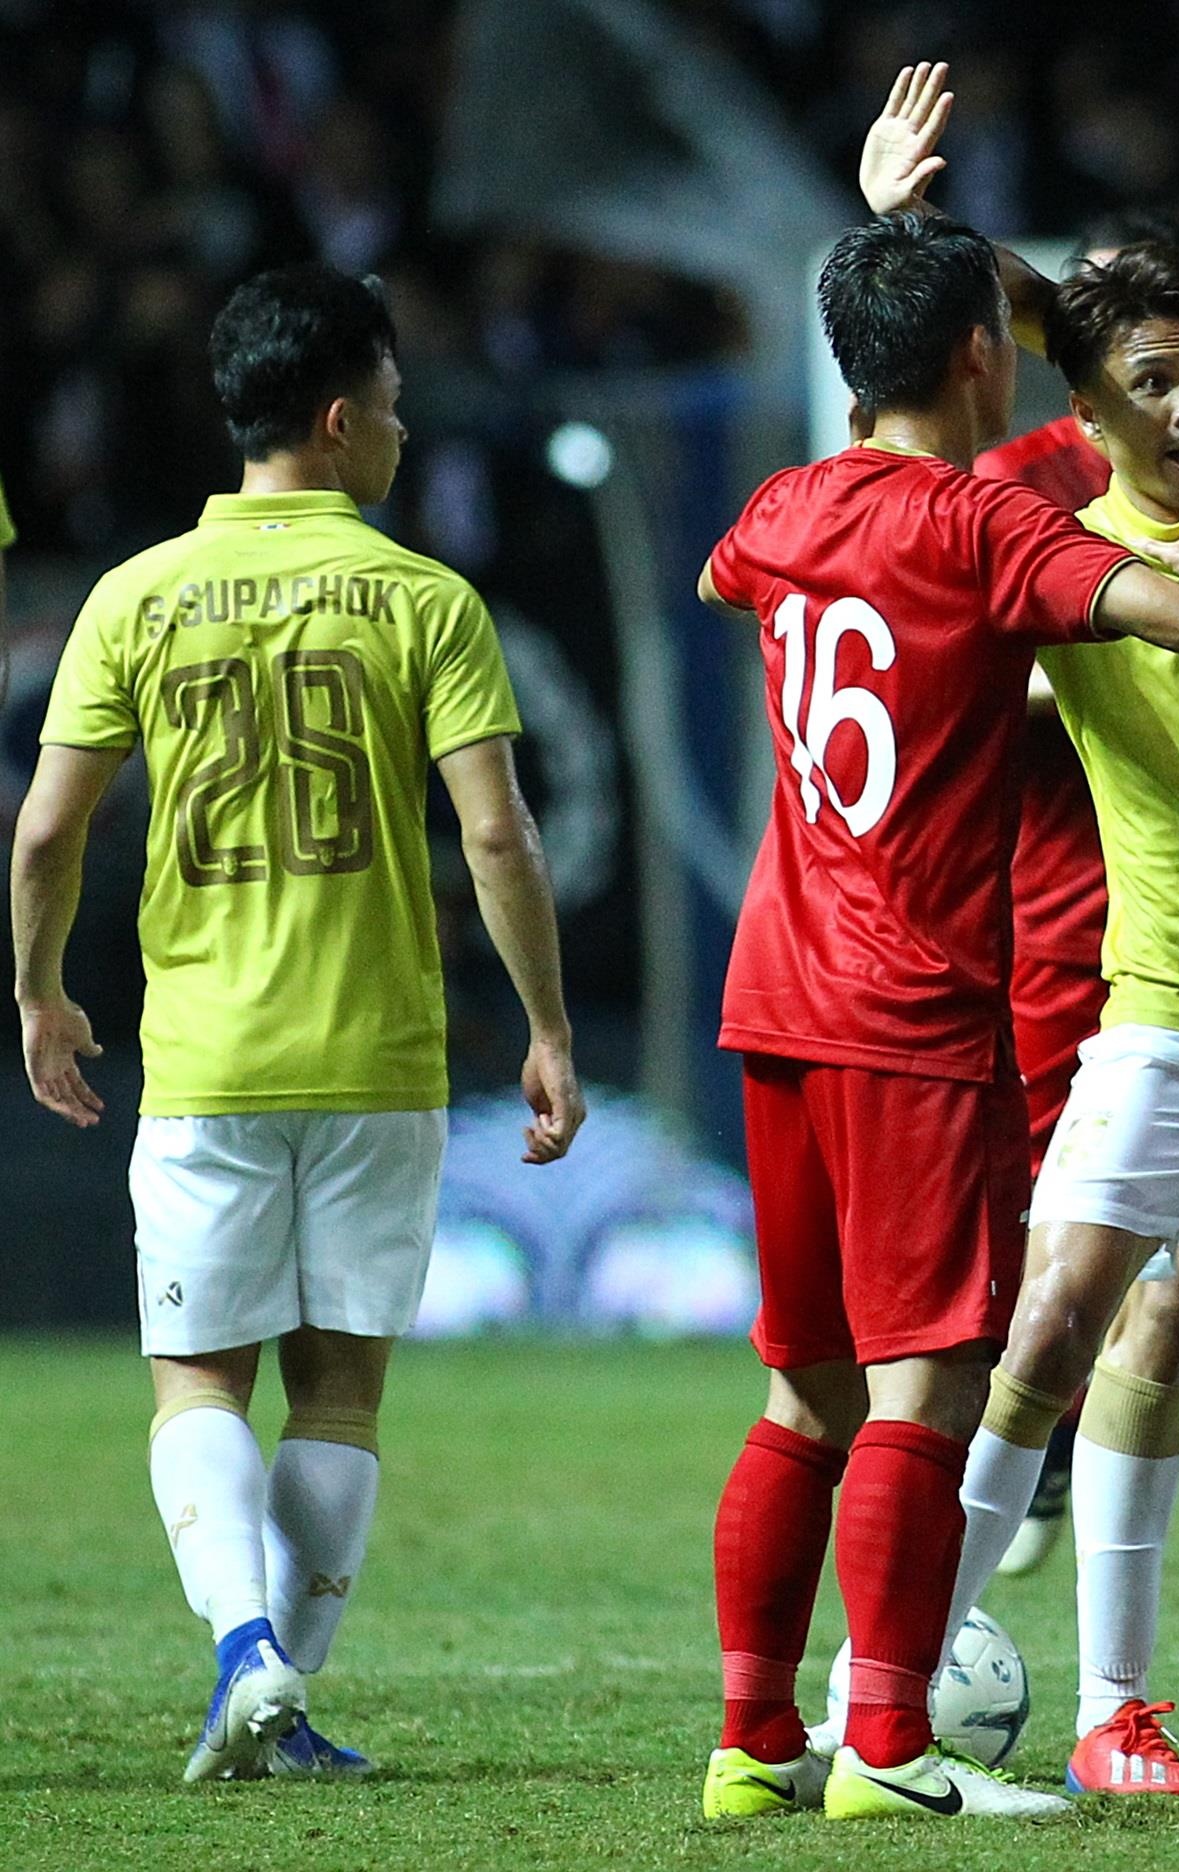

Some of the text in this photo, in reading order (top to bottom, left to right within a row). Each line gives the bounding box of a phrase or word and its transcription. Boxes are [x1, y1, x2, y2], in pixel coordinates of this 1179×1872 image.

[141, 574, 401, 640] S.SUPACHOK
[773, 592, 897, 838] 16
[160, 649, 374, 887] 28
